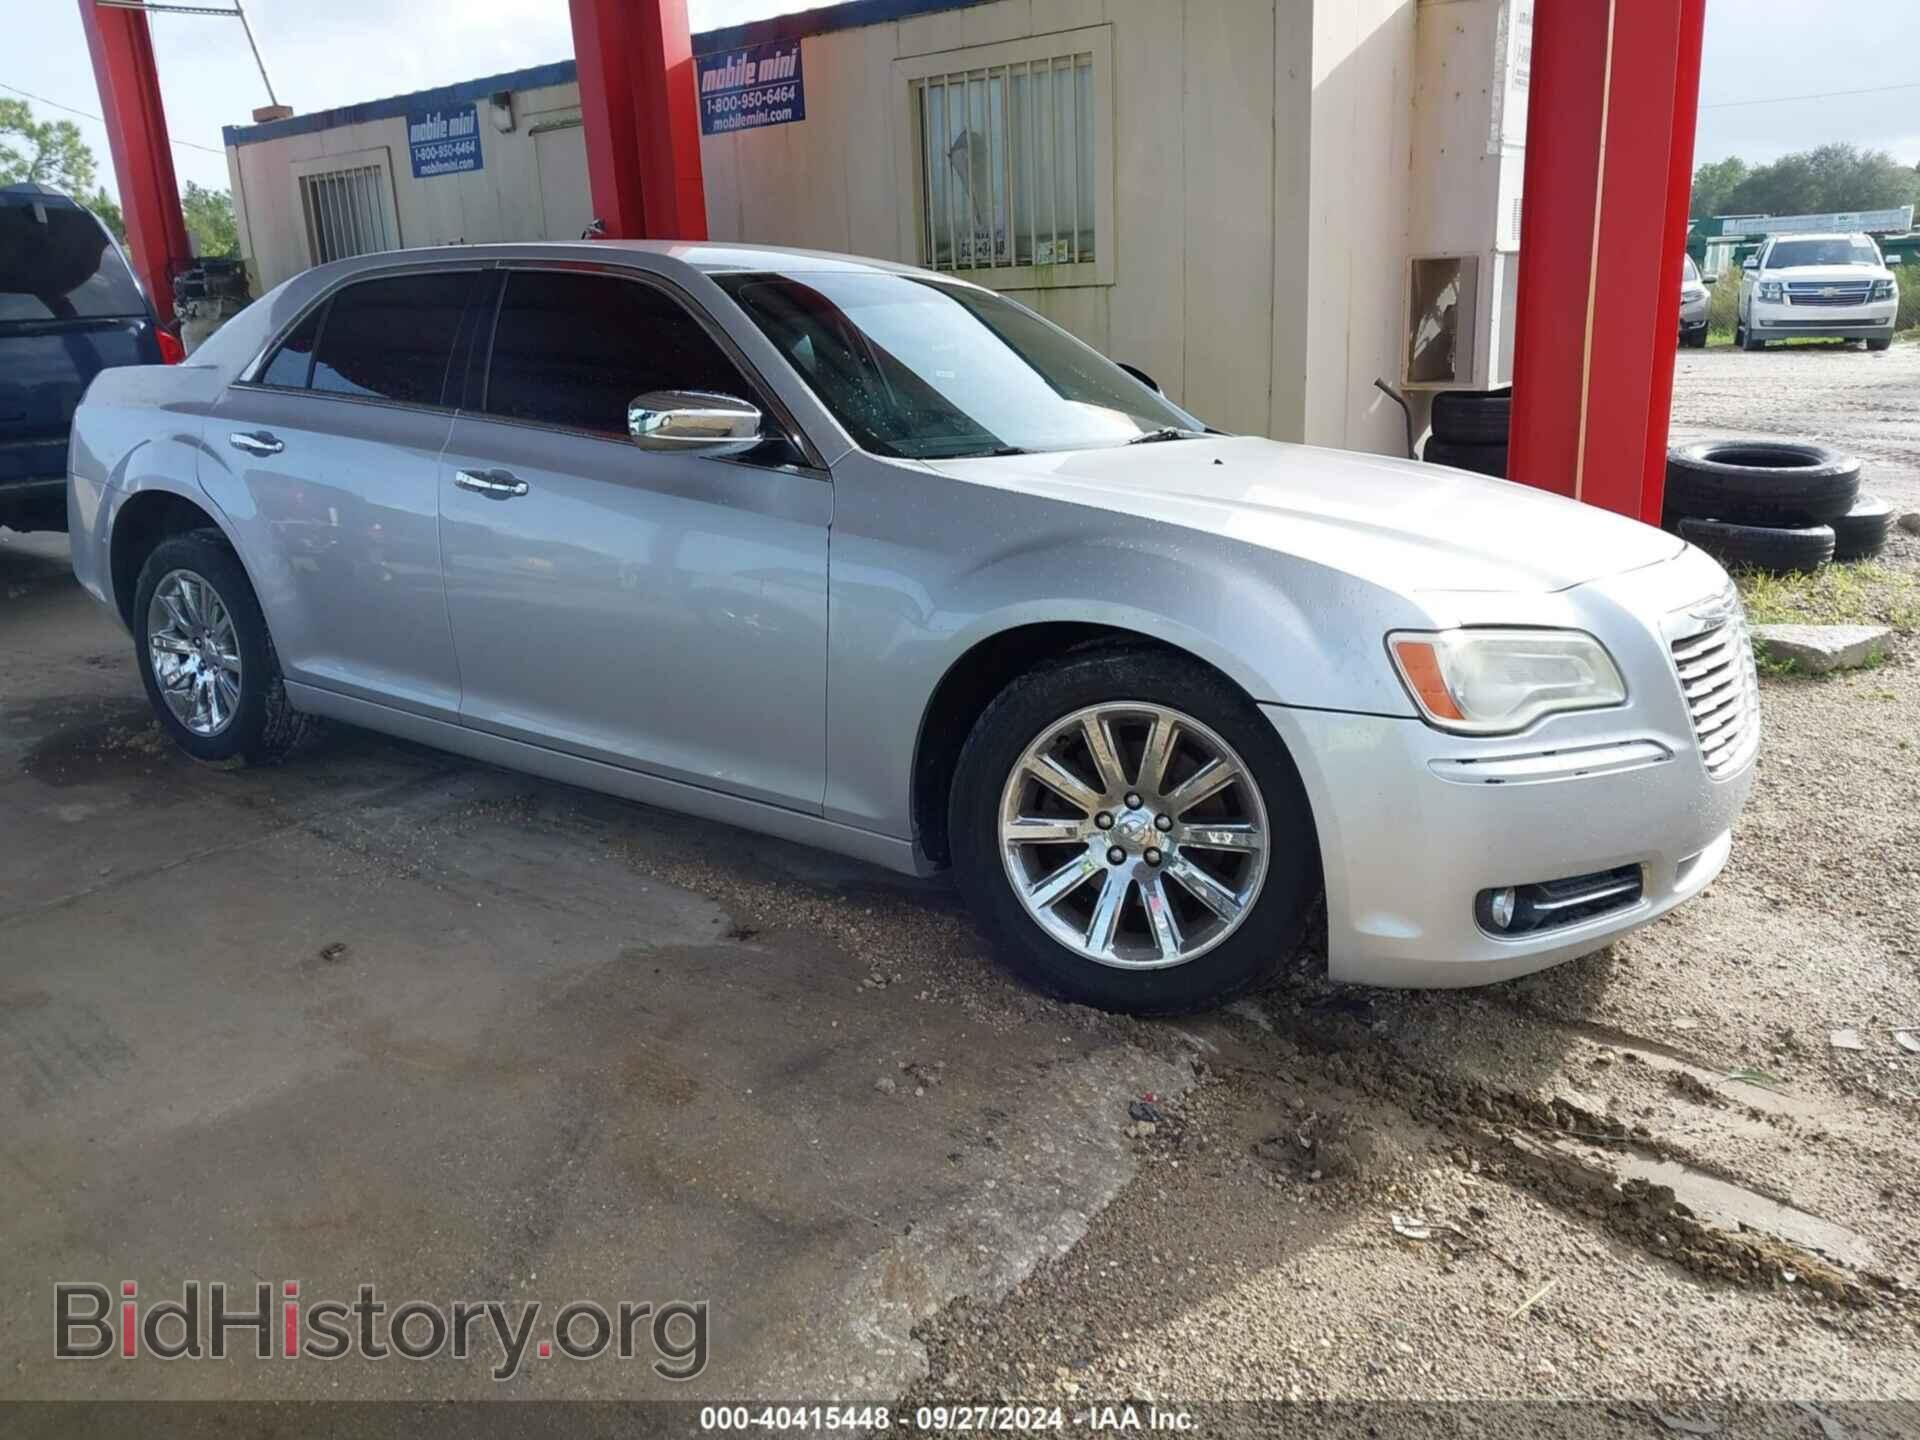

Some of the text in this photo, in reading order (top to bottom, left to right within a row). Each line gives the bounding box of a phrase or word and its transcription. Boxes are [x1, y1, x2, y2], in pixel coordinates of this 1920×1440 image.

[702, 47, 799, 92] mobile mini
[706, 85, 796, 115] 1-800-950-6464
[410, 110, 475, 143] mobile mini
[712, 107, 792, 131] mobilemini.com
